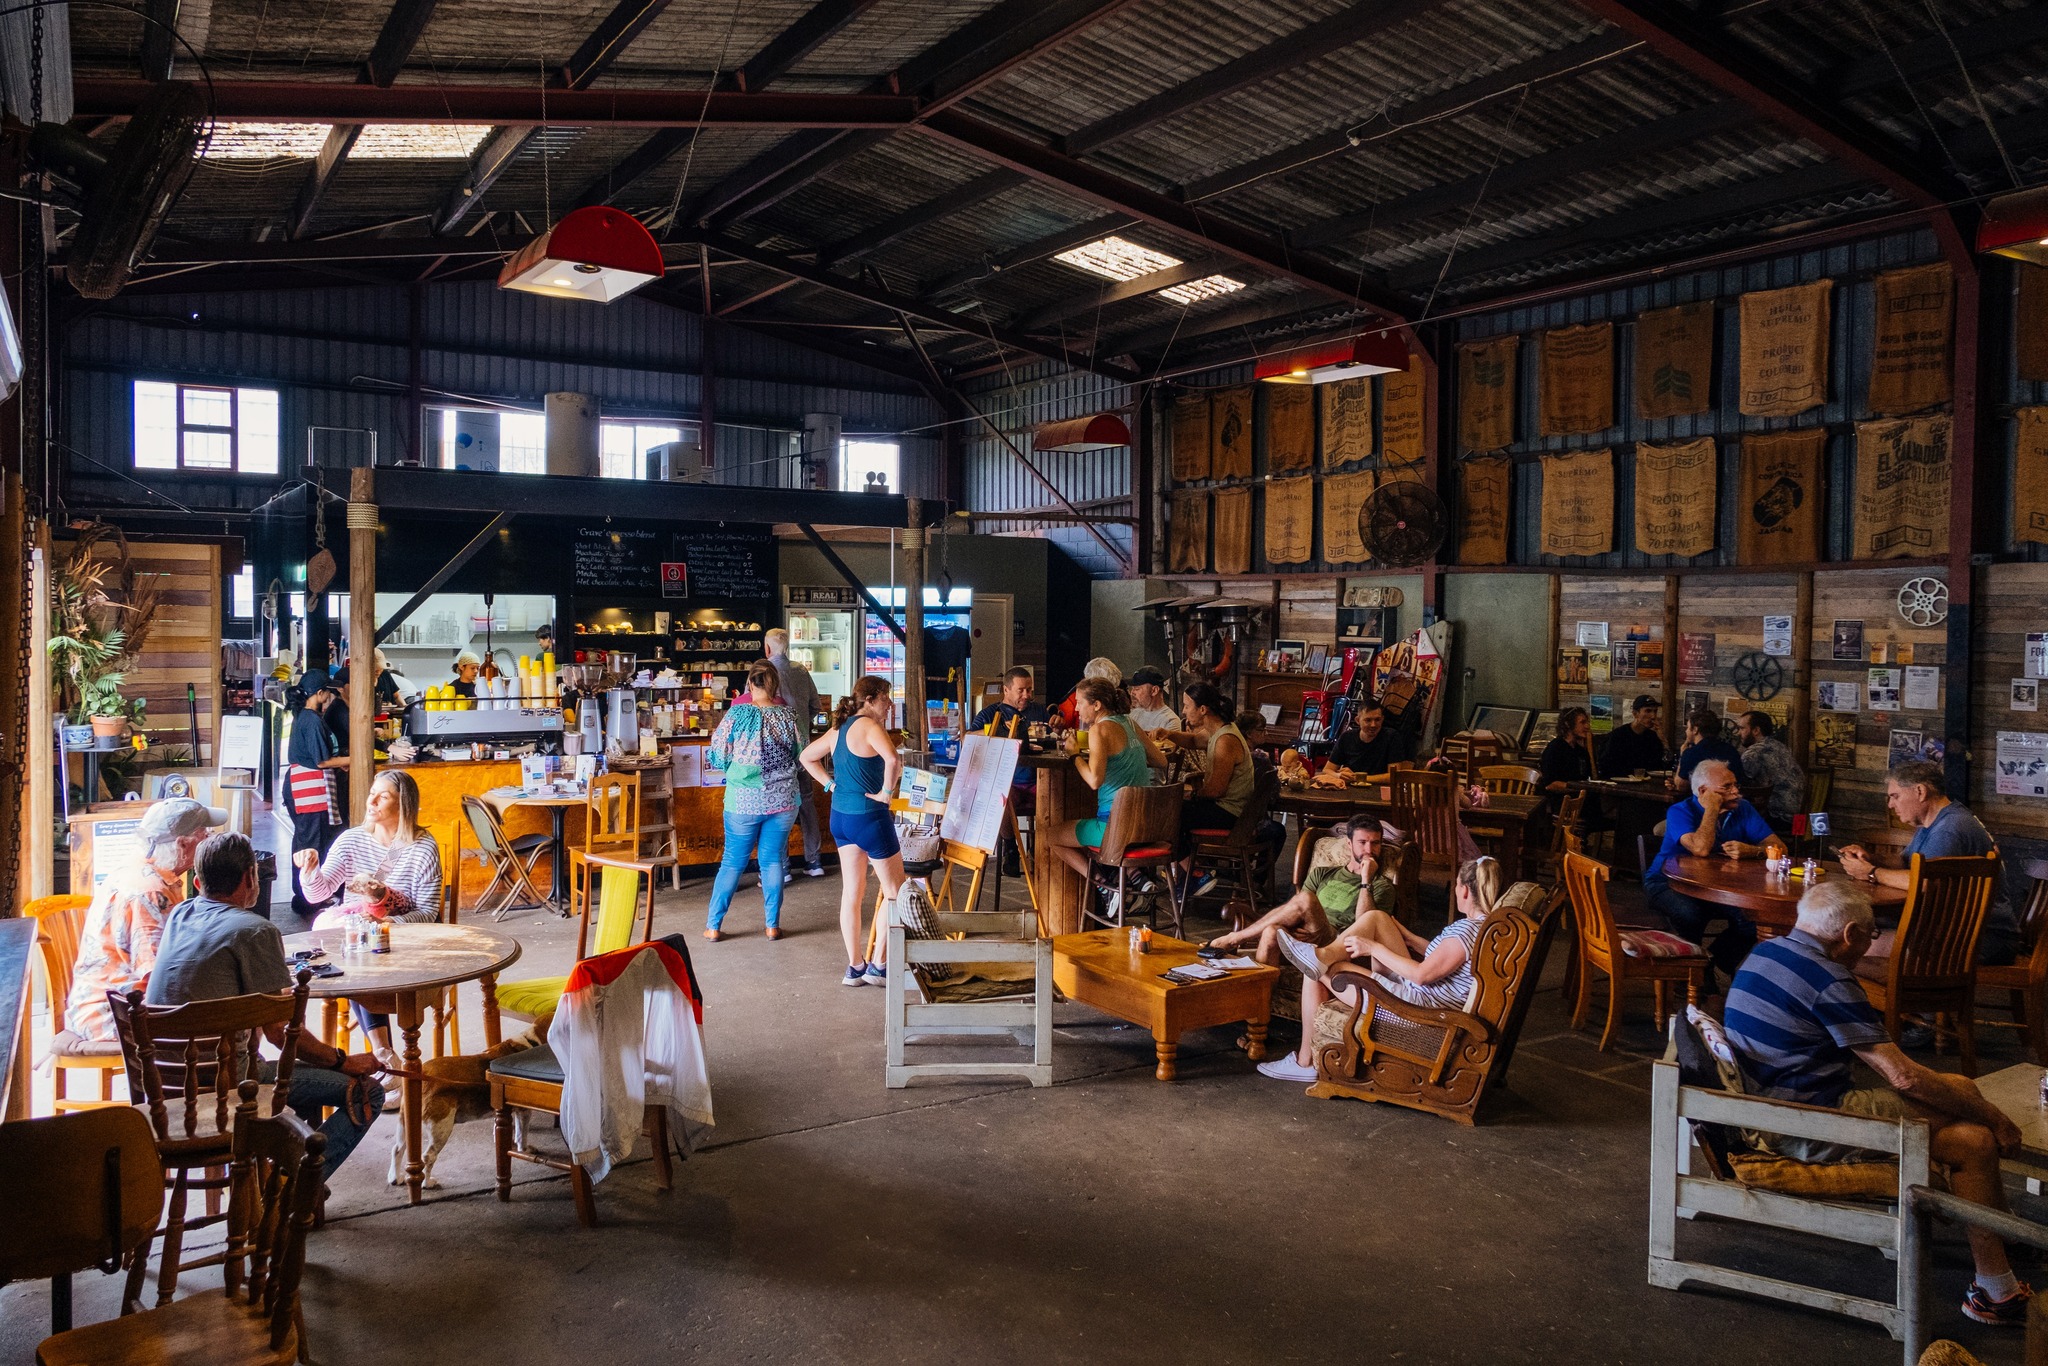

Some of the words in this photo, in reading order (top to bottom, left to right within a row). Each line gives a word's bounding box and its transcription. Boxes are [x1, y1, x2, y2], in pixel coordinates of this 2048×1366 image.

[1760, 314, 1811, 328] SUPREMO
[1763, 344, 1804, 358] PRODUCT
[1751, 394, 1758, 403] 3
[1558, 468, 1598, 478] SUPREMO
[1652, 492, 1699, 504] PRODUCT
[1668, 508, 1682, 518] OF
[1558, 516, 1595, 524] COLOMBIA
[1646, 521, 1702, 534] COLOMBIA
[1648, 538, 1660, 549] 70
[1814, 816, 1826, 832] 6
